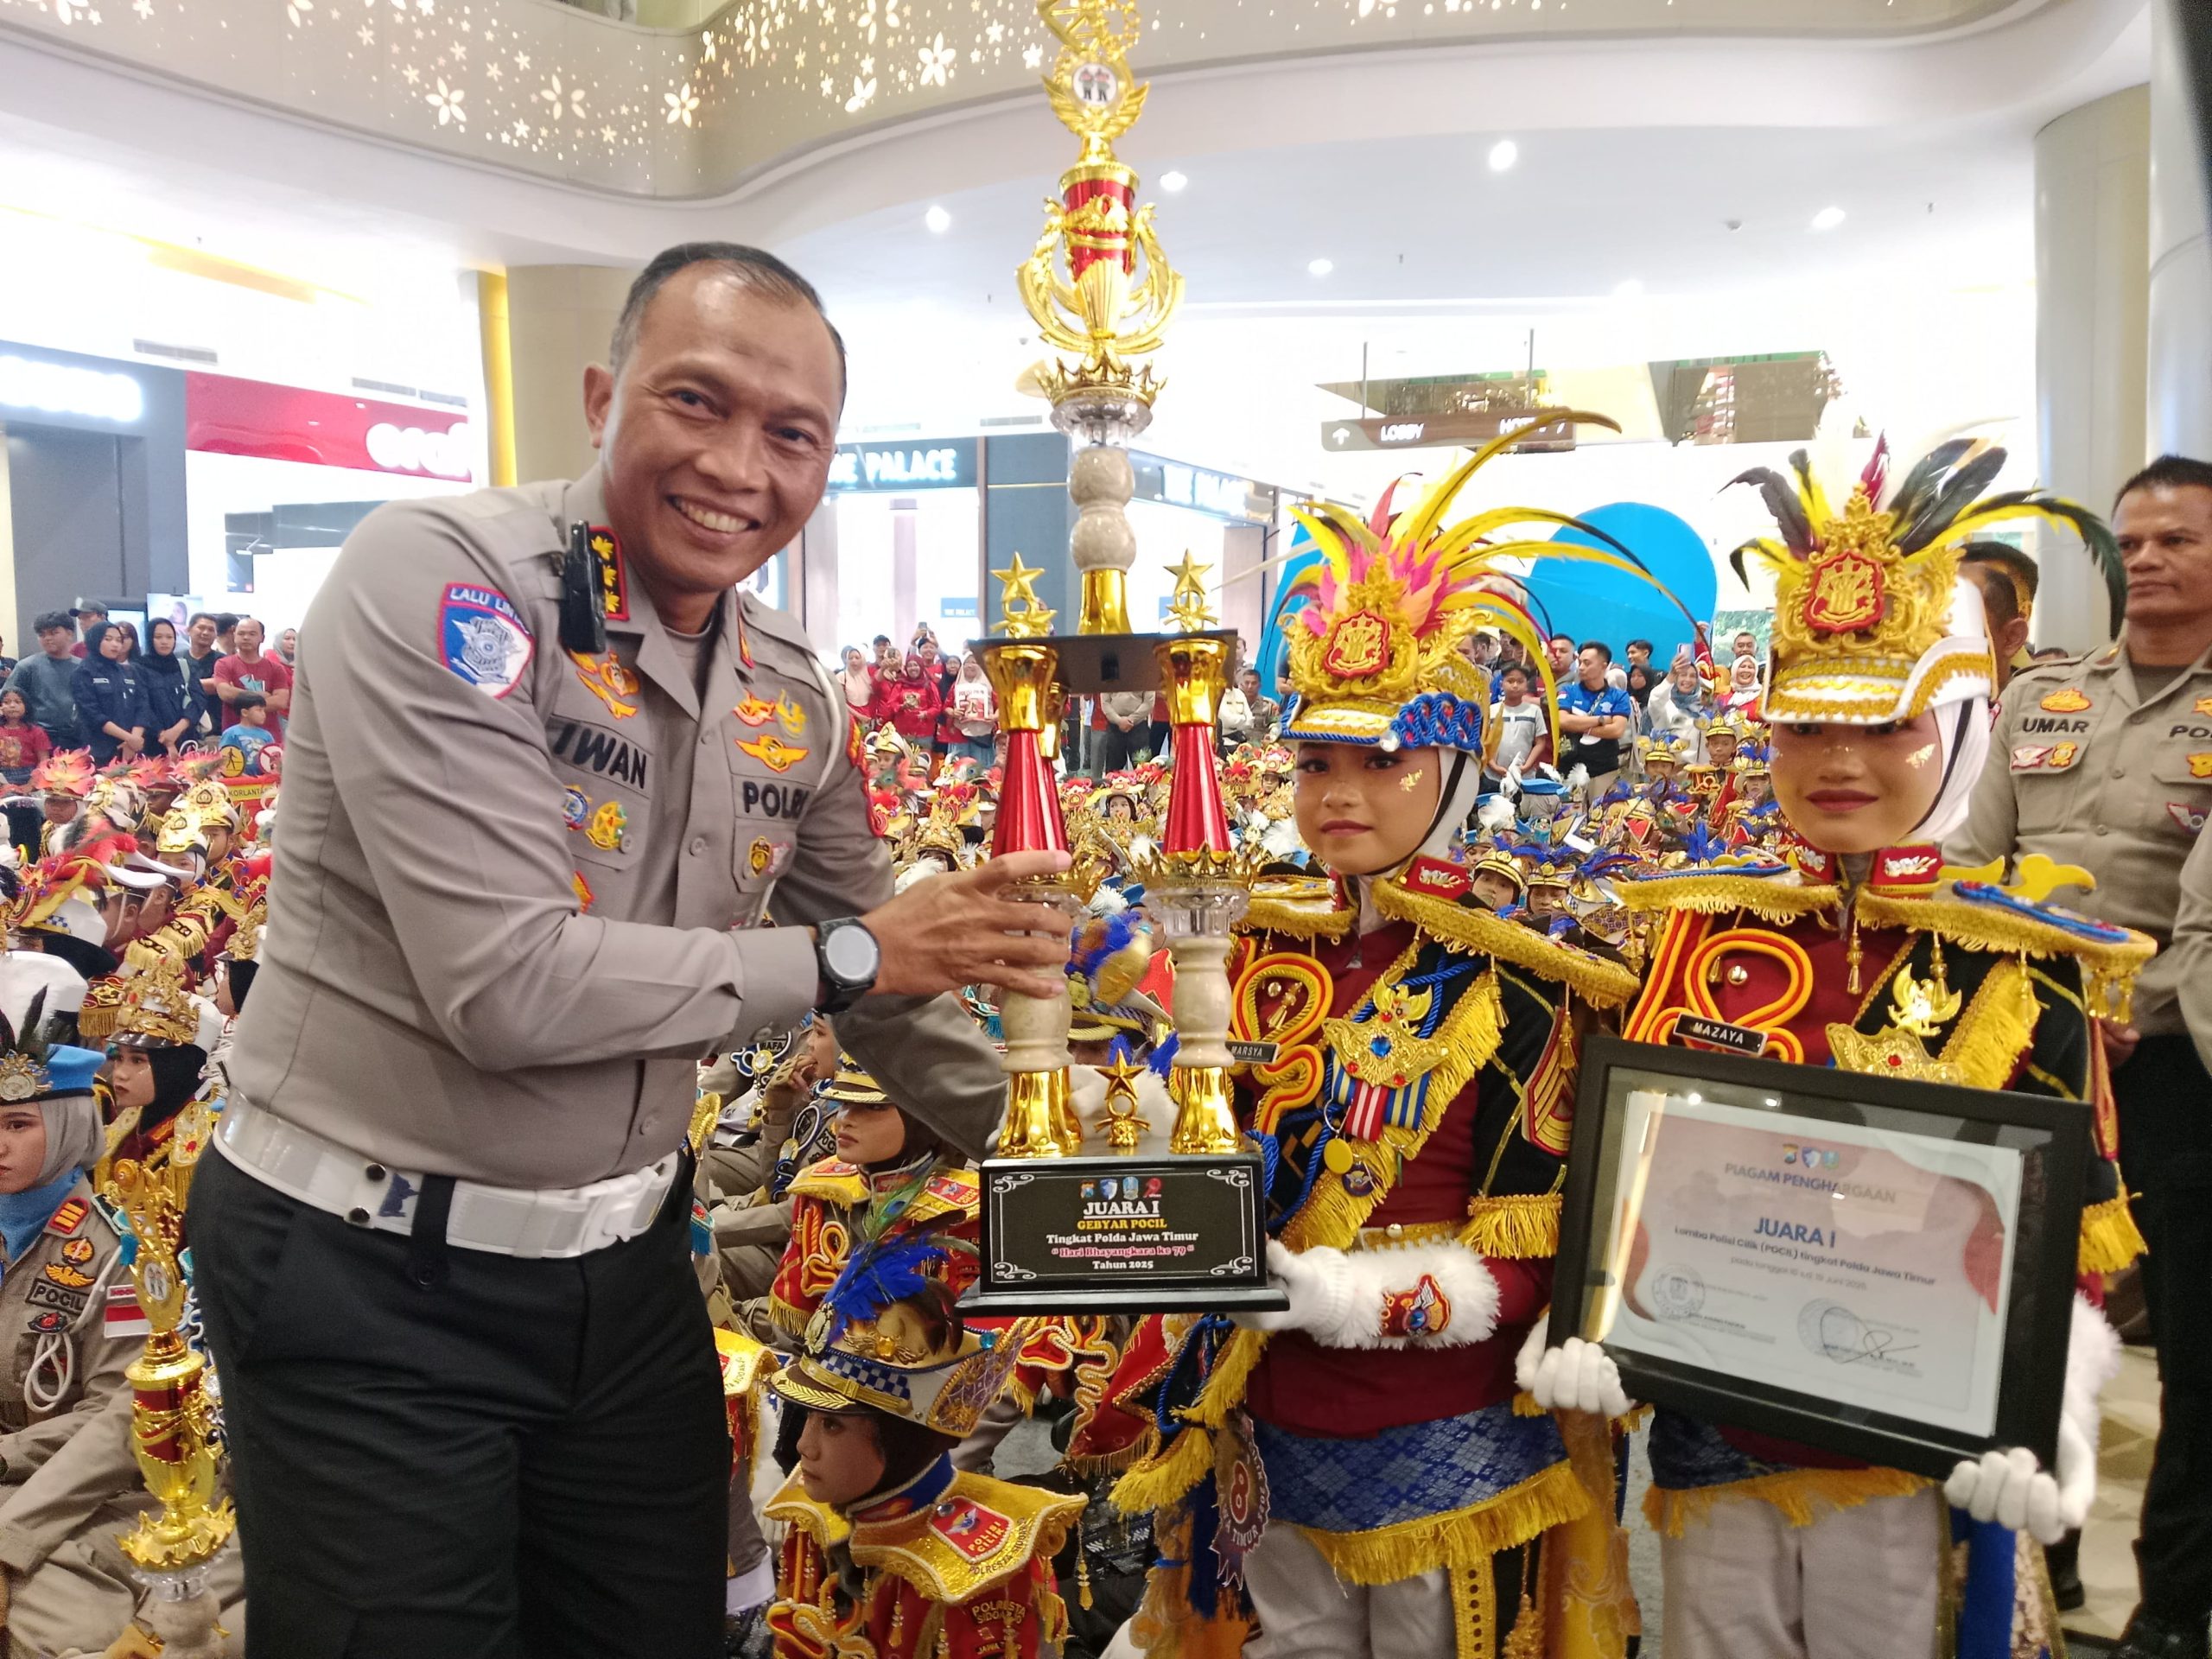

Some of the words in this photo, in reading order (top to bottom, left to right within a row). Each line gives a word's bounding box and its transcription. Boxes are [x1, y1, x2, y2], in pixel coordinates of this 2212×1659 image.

[865, 448, 957, 482] PALACE
[450, 587, 491, 606] LALU
[2022, 717, 2089, 734] UMAR
[2169, 725, 2212, 739] PO
[553, 722, 646, 790] IWAN
[1692, 1022, 1744, 1045] MAZAYA
[1230, 1046, 1262, 1057] MARSYA
[1724, 1163, 1780, 1184] PIAGAM
[1783, 1174, 1897, 1204] PENGHARGAAN
[1084, 1200, 1148, 1216] JUARA
[1152, 1200, 1160, 1214] I
[1077, 1220, 1128, 1230] GEBYAR
[1130, 1218, 1167, 1229] POCIL
[1754, 1217, 1823, 1246] JUARA
[1830, 1230, 1836, 1249] I
[1046, 1234, 1092, 1245] Tingkat
[1095, 1233, 1126, 1243] Polda
[1128, 1232, 1160, 1242] Jawa
[1161, 1231, 1198, 1242] Timur
[1059, 1247, 1084, 1258] Hari
[1085, 1246, 1156, 1258] Bhayangkara
[1157, 1244, 1171, 1255] ke
[1172, 1246, 1186, 1256] 79
[1675, 1225, 1708, 1240] Lomba
[1709, 1233, 1735, 1246] Polisi
[1801, 1252, 1838, 1266] tingkat
[1840, 1259, 1870, 1273] Polda
[1872, 1266, 1901, 1279] Jawa
[1904, 1271, 1936, 1286] Timur
[1092, 1261, 1127, 1269] Tahun
[1128, 1260, 1154, 1270] 2025
[34, 1285, 86, 1311] POCIL
[968, 1521, 1001, 1551] POLISI
[977, 1528, 1005, 1552] CILIK
[1231, 1523, 1259, 1547] TIMUR
[969, 1554, 1013, 1575] POLRESTA
